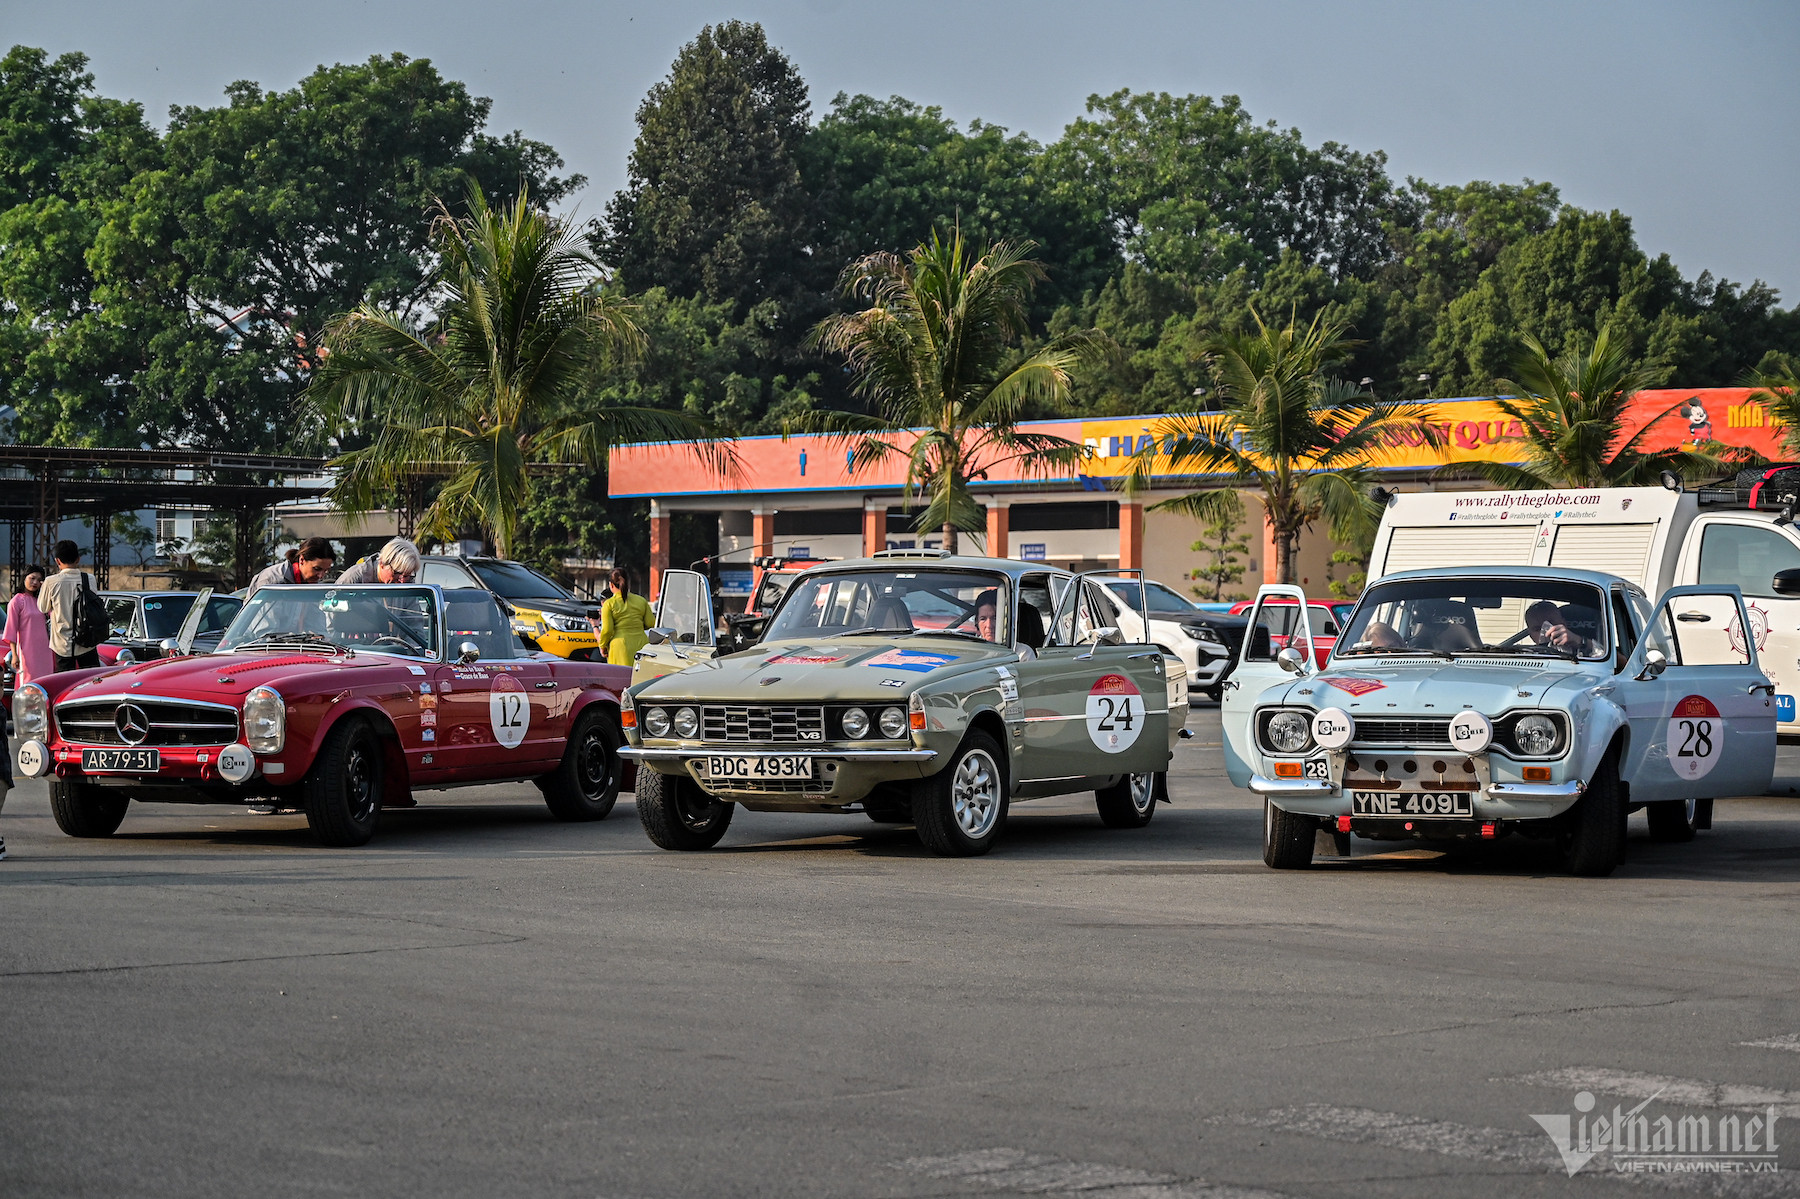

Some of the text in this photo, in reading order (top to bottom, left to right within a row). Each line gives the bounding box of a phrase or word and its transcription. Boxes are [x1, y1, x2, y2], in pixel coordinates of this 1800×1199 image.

[1455, 493, 1601, 509] www.rallytheglobe.com
[882, 679, 904, 687] 24
[499, 695, 522, 728] 12
[1097, 697, 1133, 732] 24
[800, 731, 821, 740] V8
[1677, 720, 1713, 758] 28
[711, 757, 810, 776] BDG 493K
[1305, 761, 1328, 777] 28
[1355, 793, 1469, 814] YNE 409L
